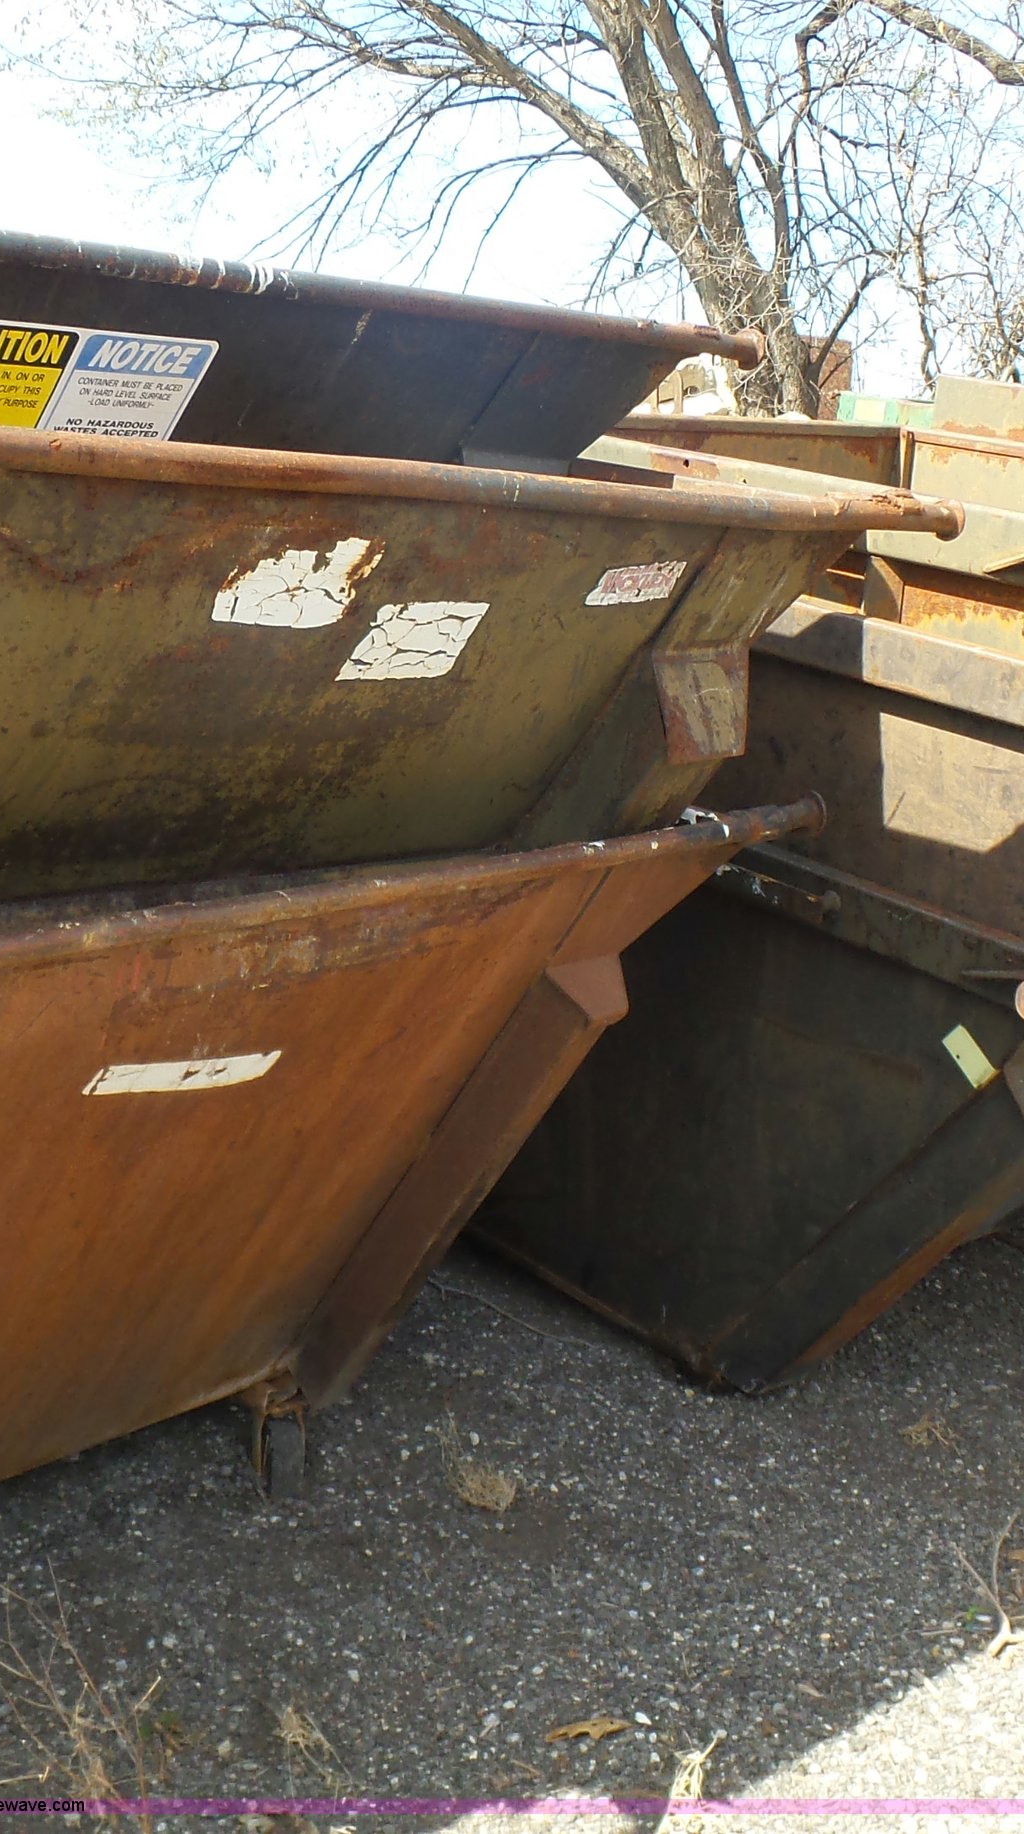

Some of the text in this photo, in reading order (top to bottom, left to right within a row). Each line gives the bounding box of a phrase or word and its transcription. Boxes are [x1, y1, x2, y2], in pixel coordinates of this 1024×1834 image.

[88, 339, 202, 375] NOTICE
[15, 372, 29, 381] ON
[31, 373, 45, 382] OR
[77, 376, 184, 392] CONTAINER MUST BE PLACED
[23, 386, 41, 395] THIS
[79, 387, 173, 401] ON HARD LEVEL SURFACE
[2, 398, 39, 409] PURPOSE
[66, 418, 155, 430] NO HAZARDOUS
[101, 430, 159, 438] ACCEPTED
